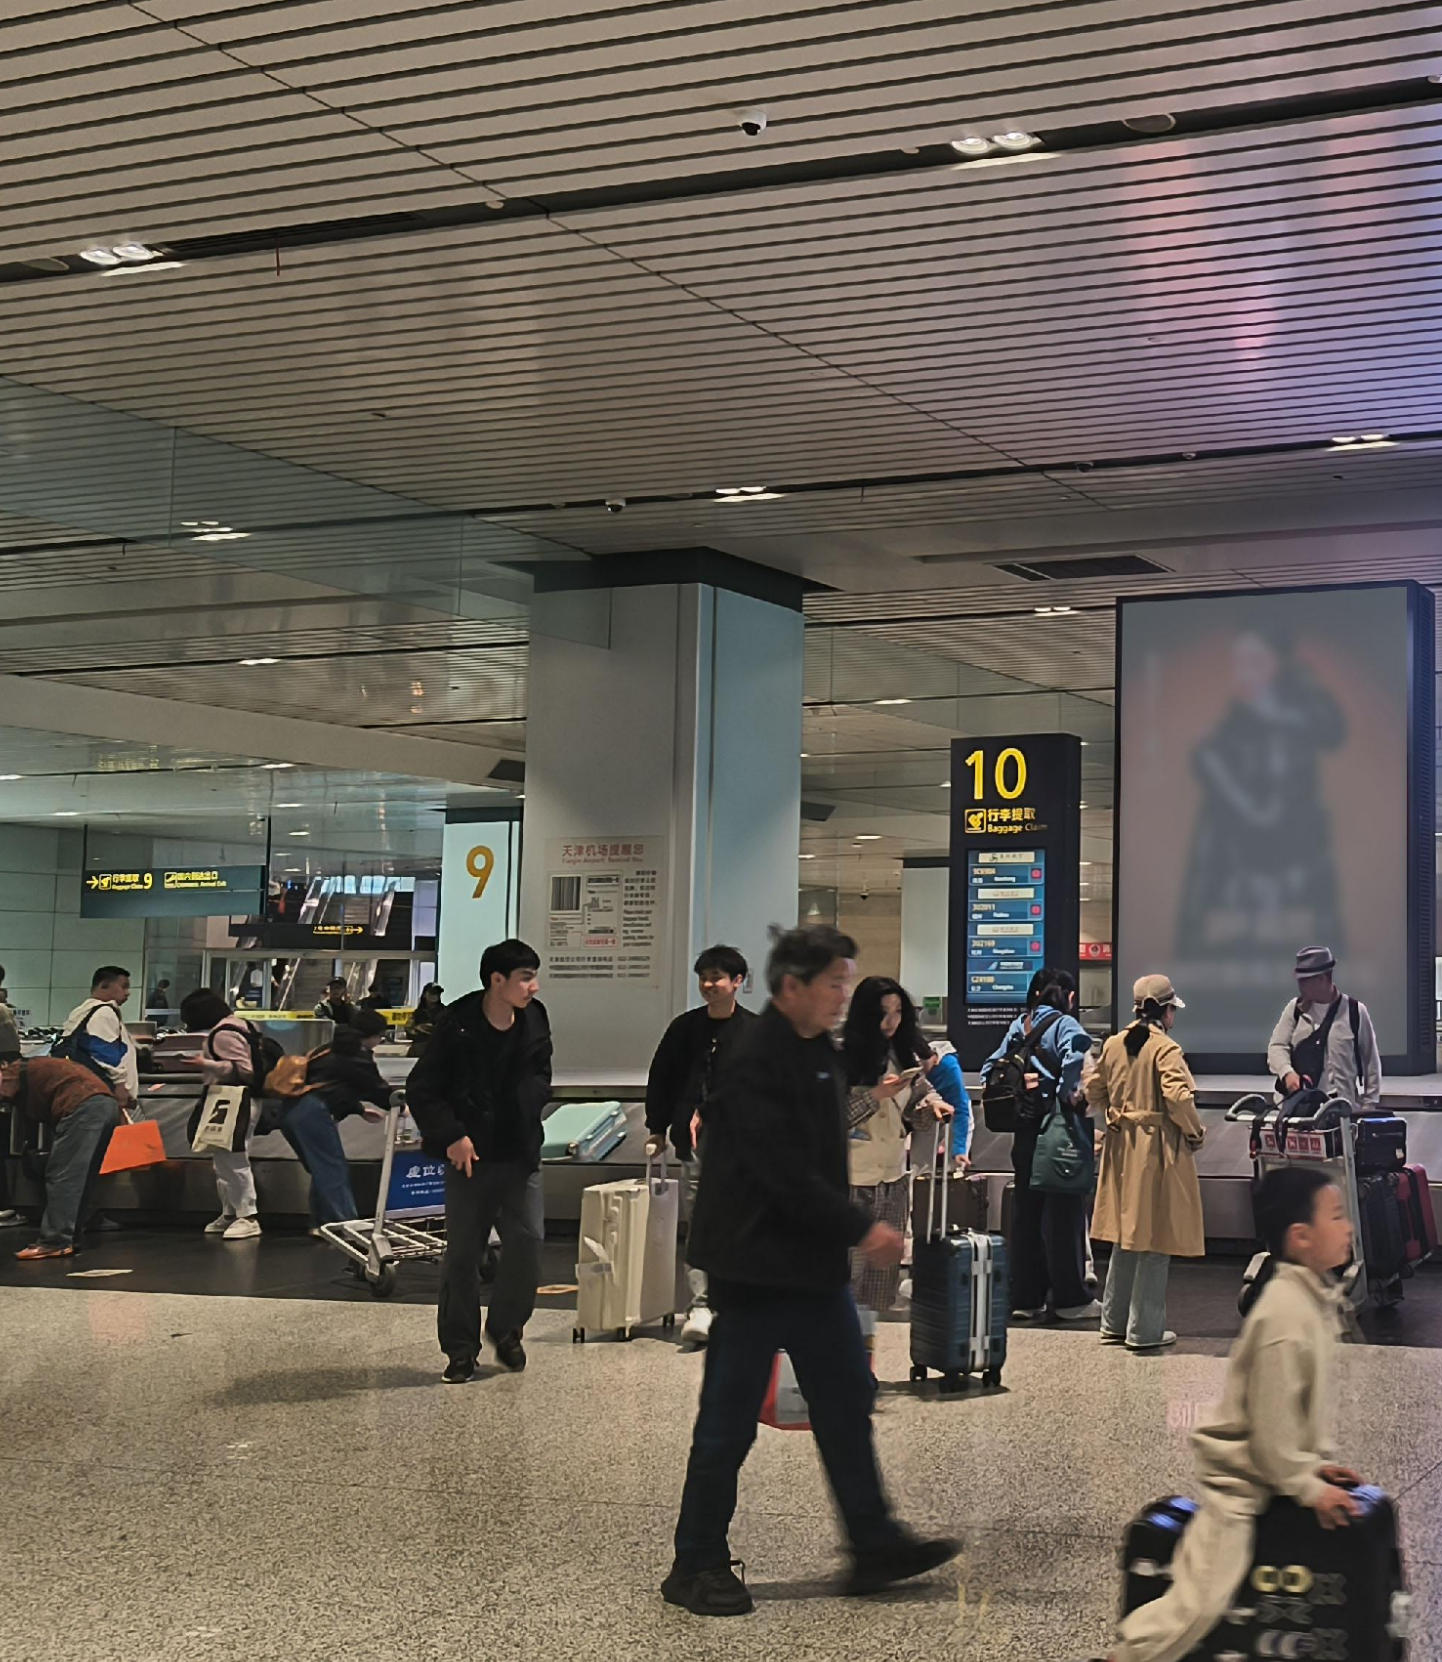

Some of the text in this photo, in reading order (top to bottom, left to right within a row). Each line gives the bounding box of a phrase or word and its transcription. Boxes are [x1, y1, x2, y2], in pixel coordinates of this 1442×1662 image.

[965, 747, 1027, 800] 10
[987, 807, 1036, 822] 行李提取
[987, 823, 1023, 835] Baggage
[562, 843, 644, 857] 天津机场提醒您
[466, 845, 495, 899] 9
[143, 873, 153, 890] 9
